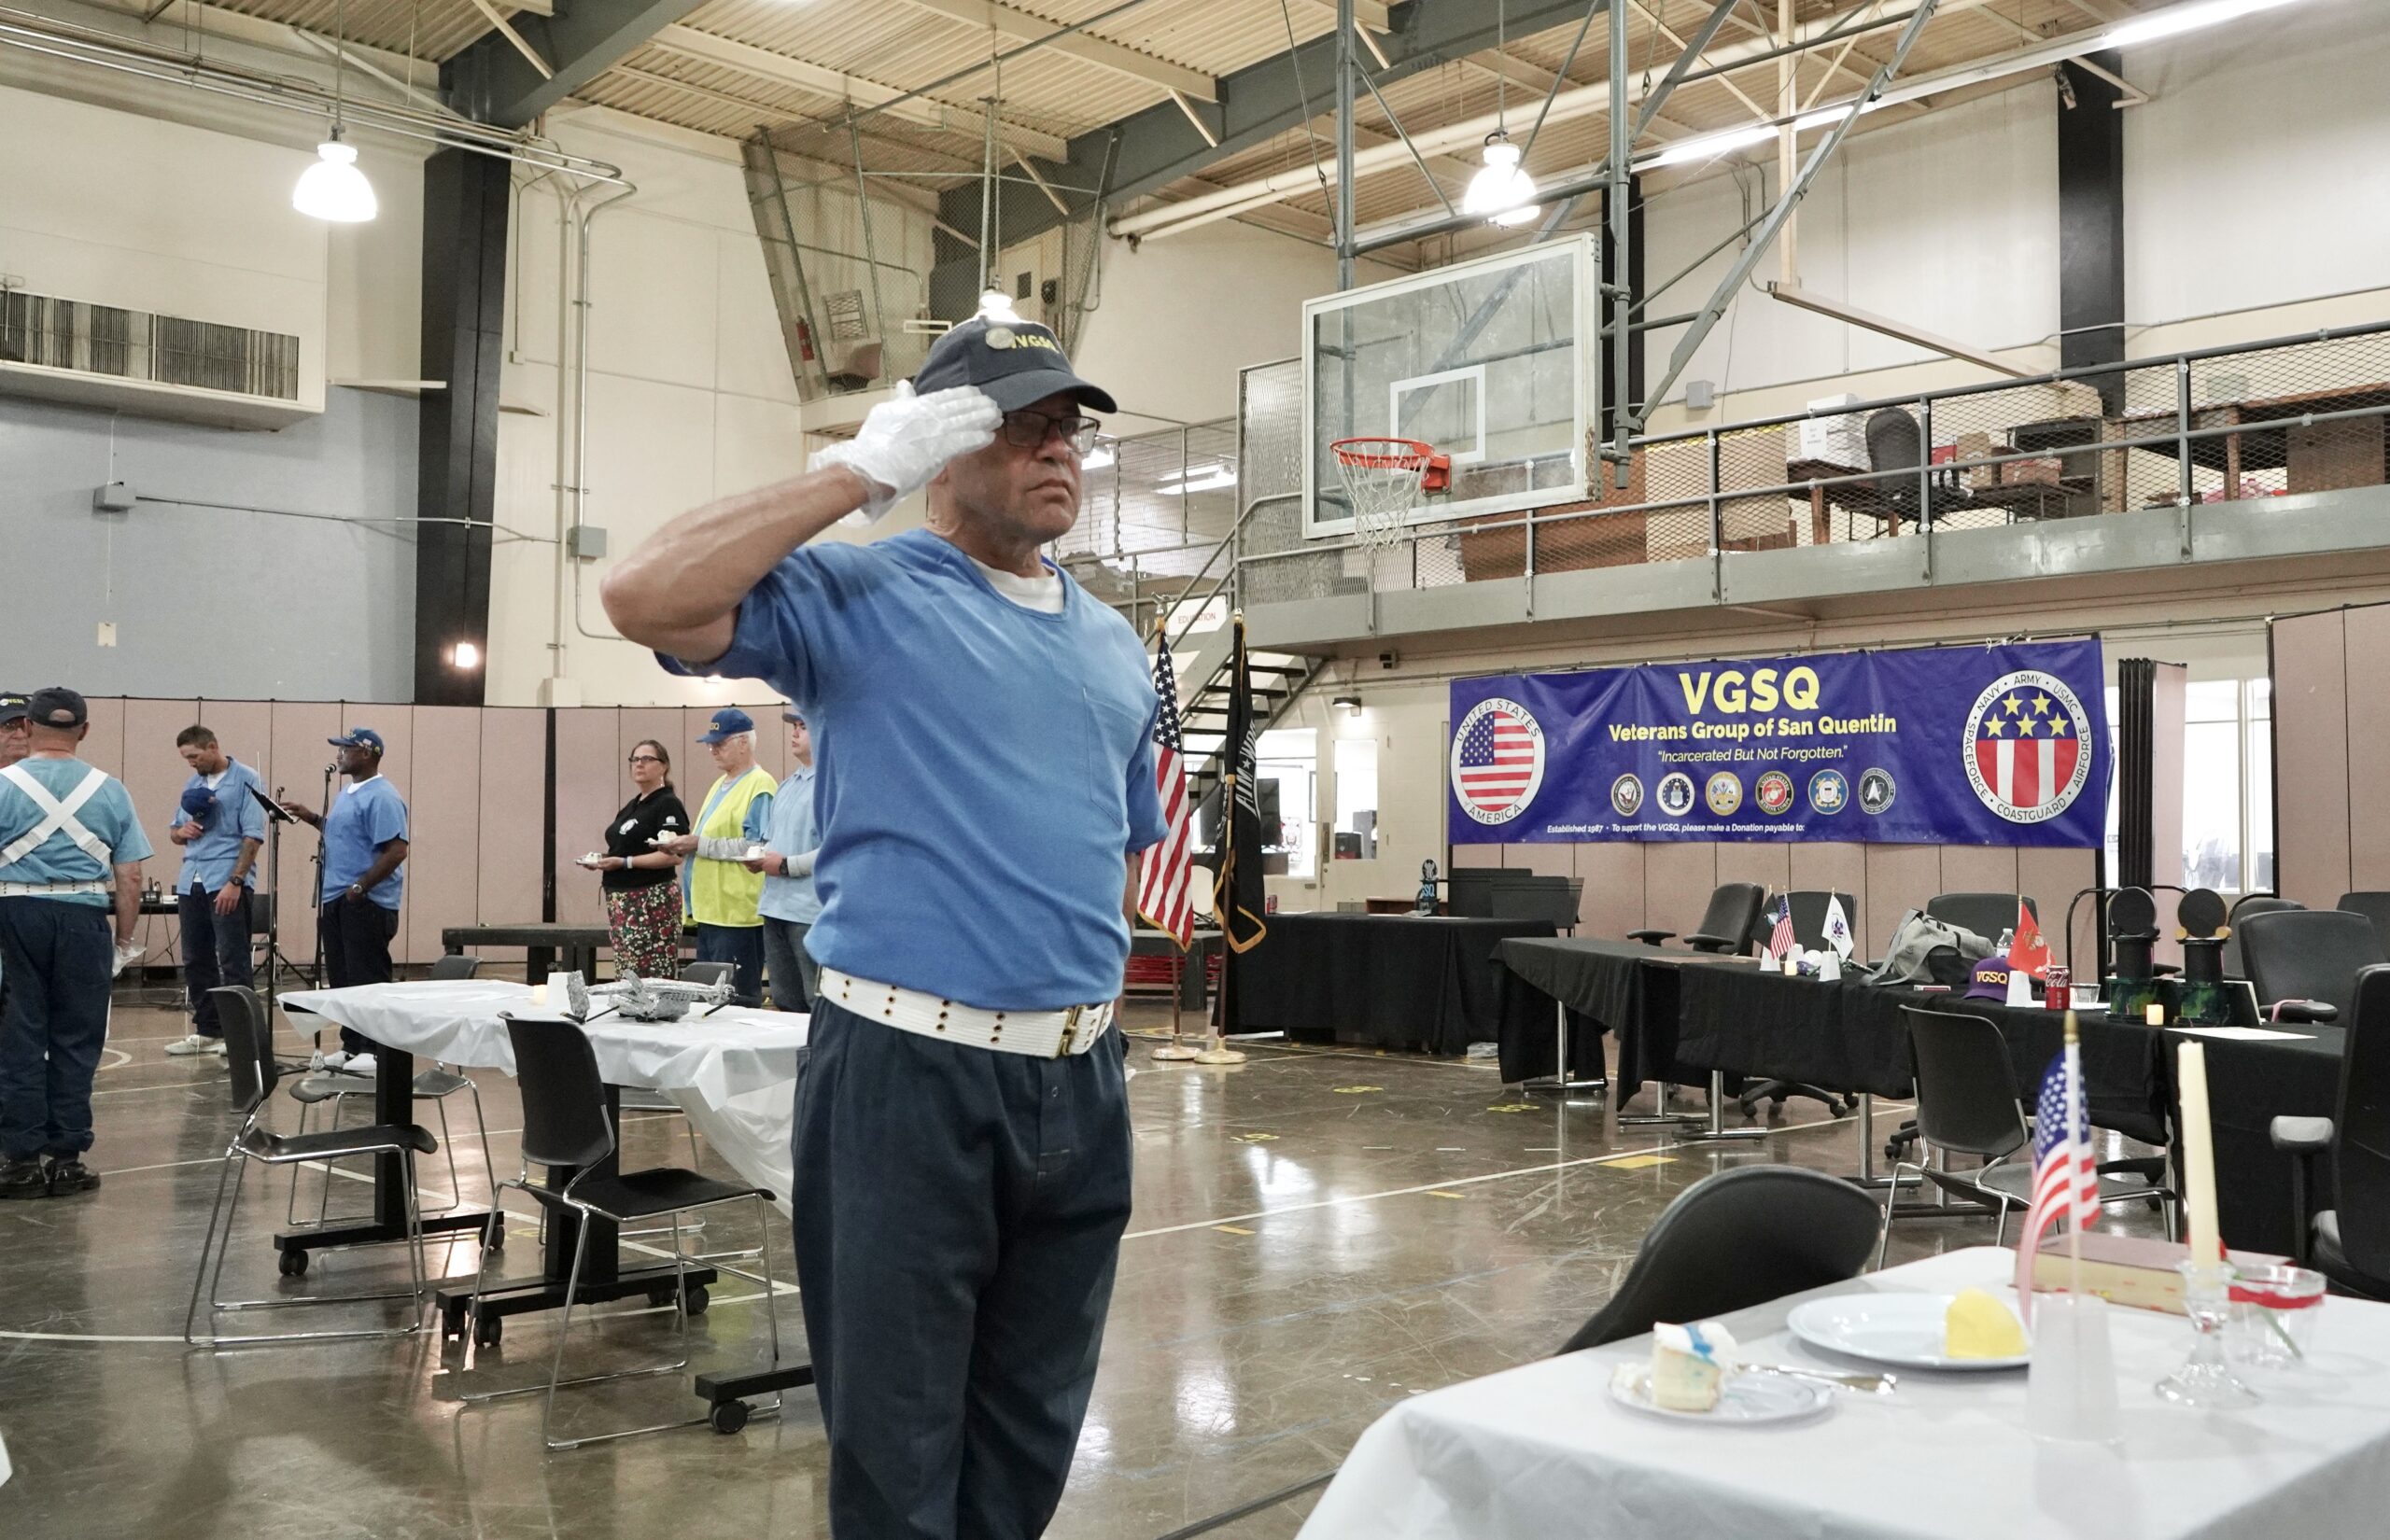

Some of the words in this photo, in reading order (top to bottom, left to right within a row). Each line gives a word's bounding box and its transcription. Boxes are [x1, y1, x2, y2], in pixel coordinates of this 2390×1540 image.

[1178, 612, 1216, 624] EDUATION
[1680, 665, 1820, 714] VGSQ
[2013, 674, 2042, 686] ARMY
[1977, 684, 2001, 712] NAVY
[2054, 683, 2078, 713] USMC
[1457, 701, 1493, 742] UNITED
[1497, 700, 1540, 737] STATES
[1609, 723, 1687, 742] Veterans
[1692, 721, 1750, 743] Group
[1753, 718, 1775, 737] of
[1778, 717, 1814, 736] San
[1819, 713, 1897, 735] Quentin
[1734, 748, 1754, 762] But
[1757, 747, 1778, 761] Not
[1965, 722, 1988, 798] SPACEFORCE
[2073, 725, 2088, 789] AIRFORCE
[1469, 804, 1523, 823] AMERICA
[1997, 797, 2066, 820] COASTGUARD
[1547, 824, 1586, 833] Established
[1587, 825, 1604, 833] 1987
[1611, 823, 1620, 832] To
[1621, 823, 1642, 833] support
[1643, 823, 1656, 832] the
[1681, 823, 1706, 833] please
[1707, 823, 1724, 832] make
[1732, 822, 1764, 832] Donation
[1764, 822, 1794, 833] payable
[1976, 971, 2008, 985] VGSQ
